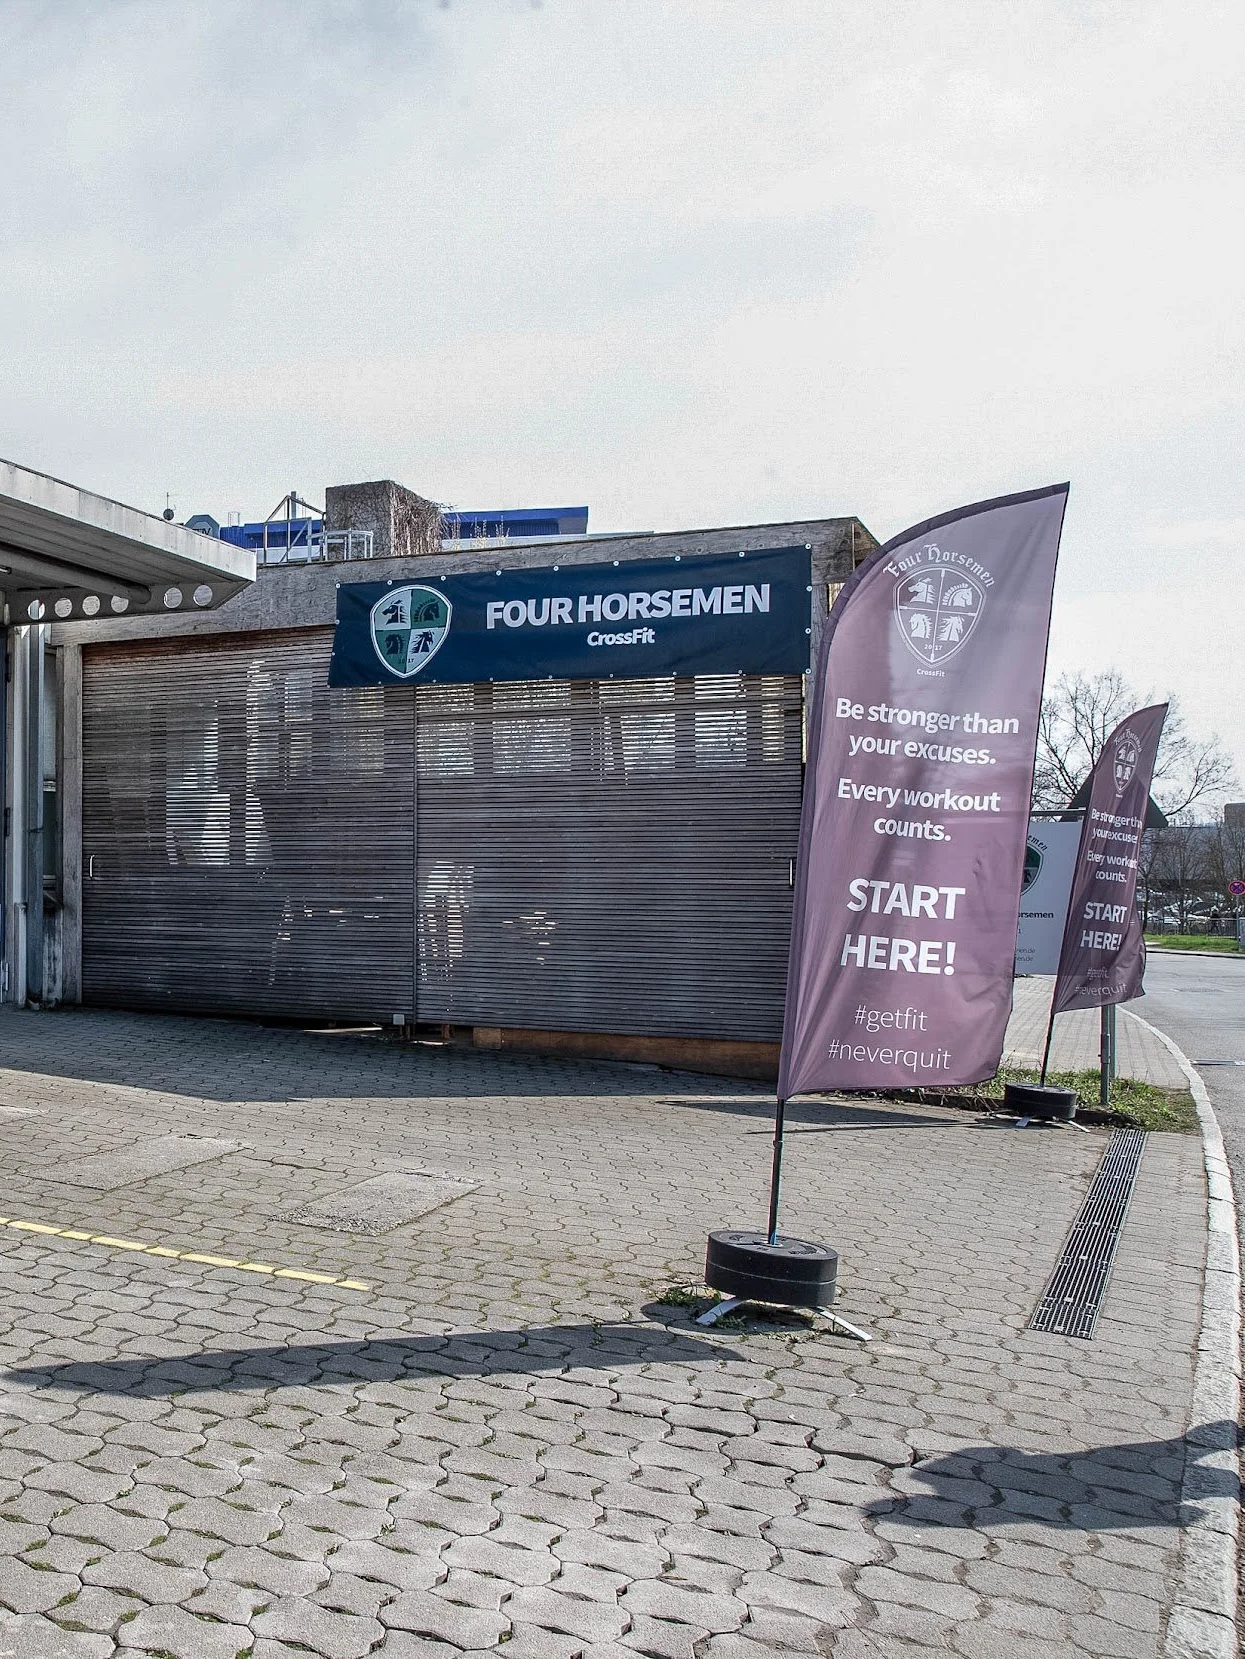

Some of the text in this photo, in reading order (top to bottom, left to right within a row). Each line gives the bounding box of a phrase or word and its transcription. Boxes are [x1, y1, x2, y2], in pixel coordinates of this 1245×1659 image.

[882, 543, 995, 588] Four Horsemen
[486, 583, 770, 630] FOUR HORSEMEN
[587, 627, 655, 647] CrossFit
[916, 668, 945, 677] CrossFit
[835, 697, 1020, 734] Be stronger than
[848, 734, 997, 765] your excuses.
[837, 777, 1001, 812] Every workout
[1091, 808, 1099, 820] Be
[873, 817, 952, 842] counts.
[1092, 828, 1107, 839] your
[1087, 850, 1105, 866] Every
[1095, 870, 1127, 883] counts.
[846, 878, 966, 920] START
[1083, 902, 1128, 924] START
[1080, 930, 1123, 951] HERE!
[840, 933, 956, 976] HERE!
[854, 1004, 928, 1033] #getfit
[828, 1039, 952, 1072] #neverquit
